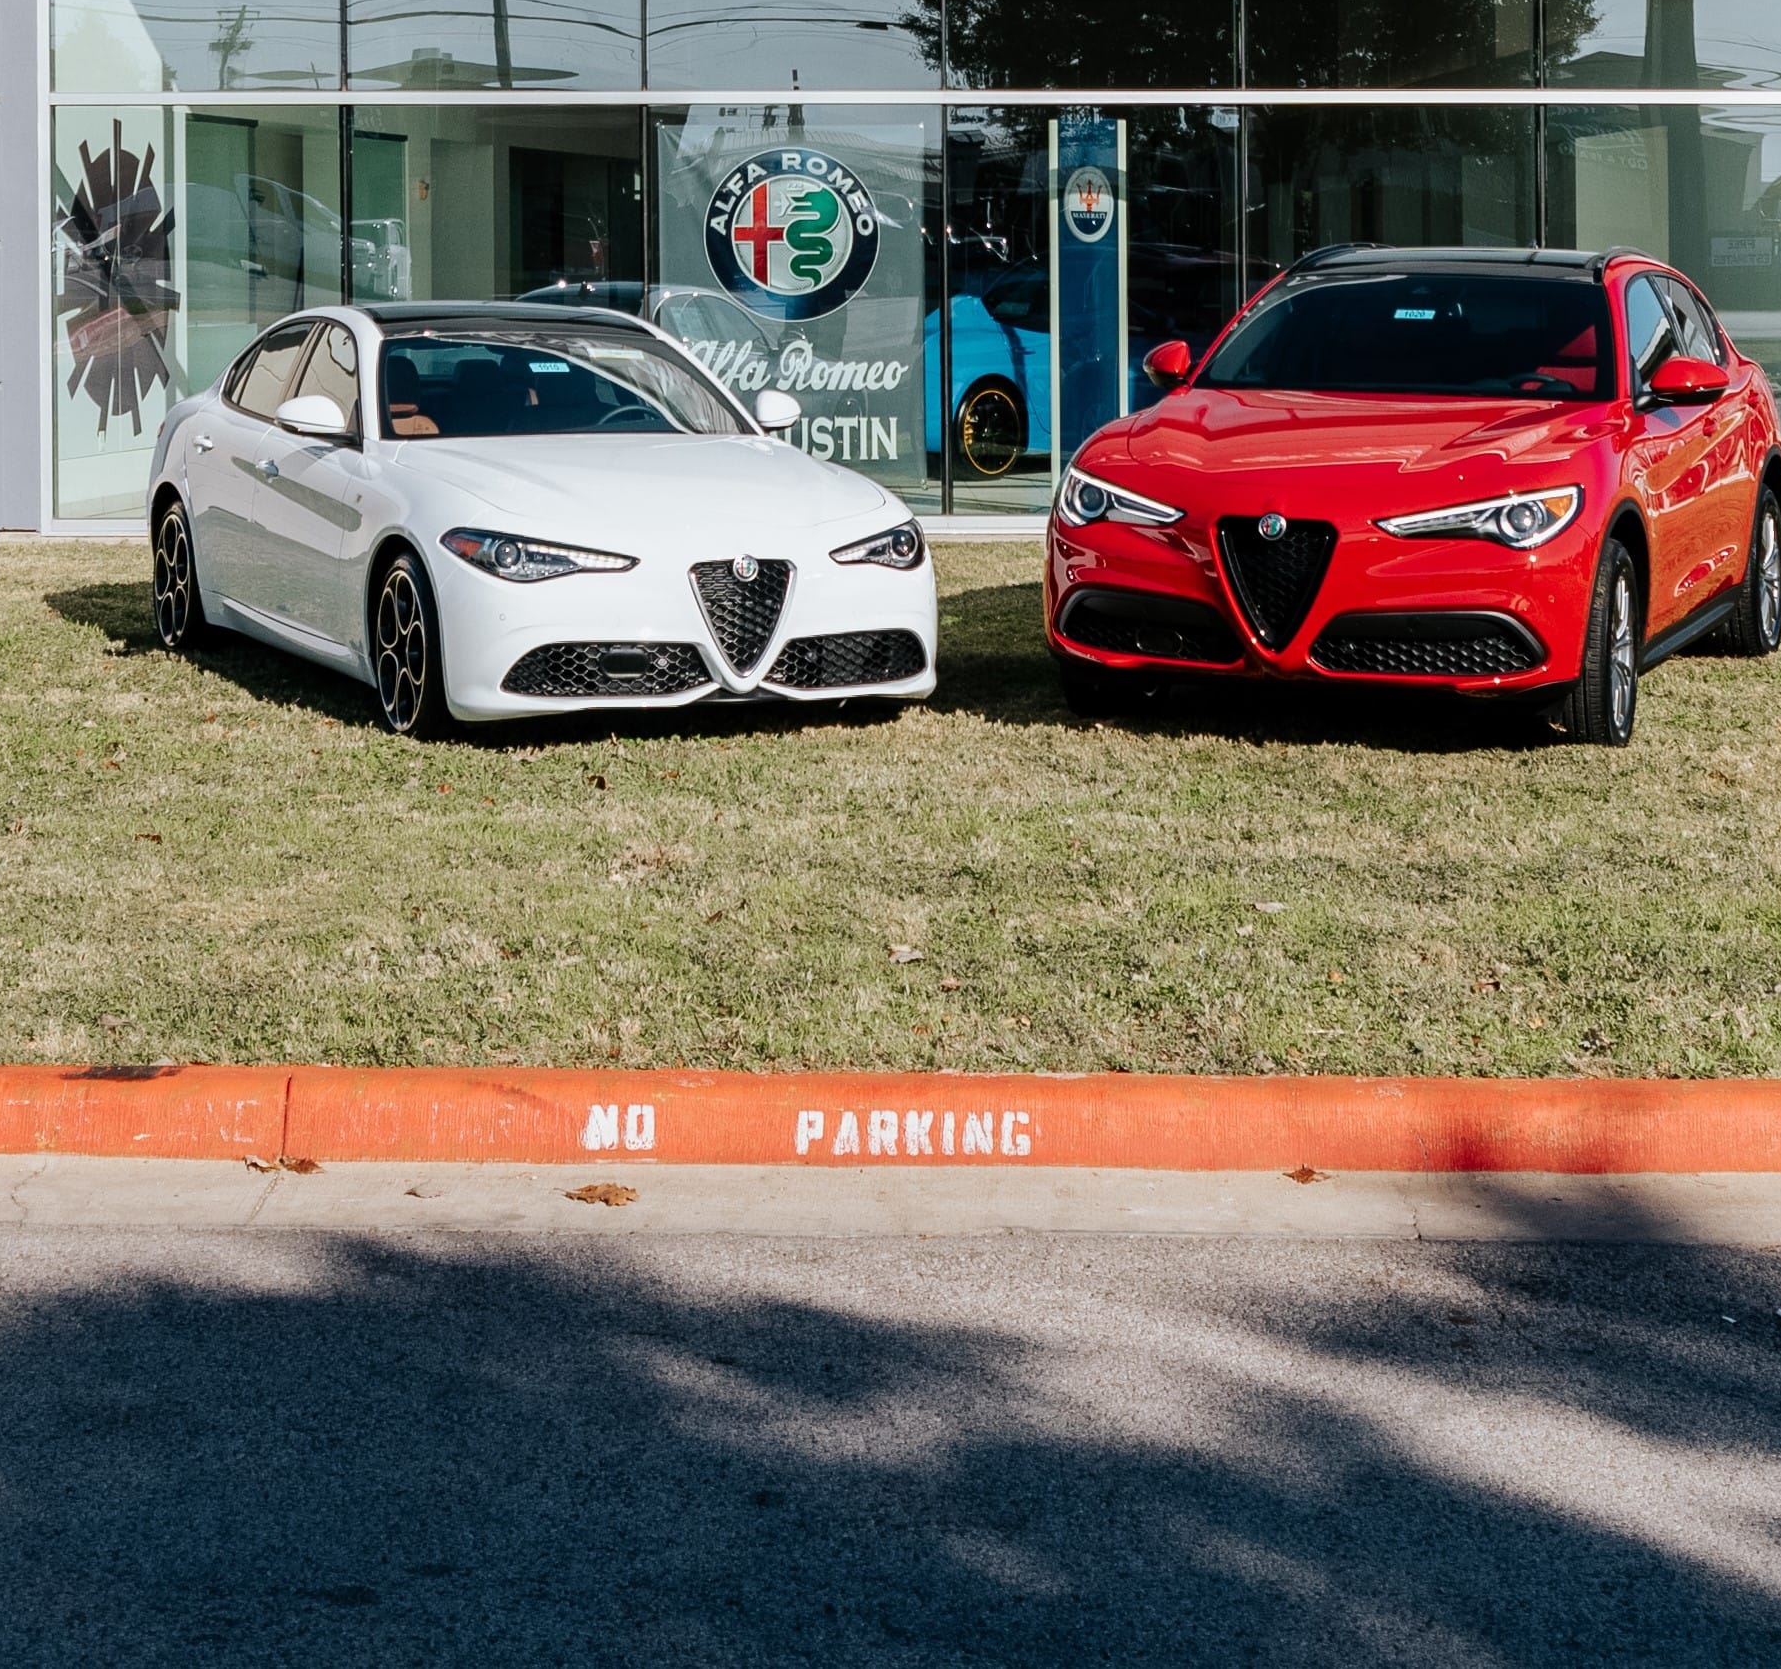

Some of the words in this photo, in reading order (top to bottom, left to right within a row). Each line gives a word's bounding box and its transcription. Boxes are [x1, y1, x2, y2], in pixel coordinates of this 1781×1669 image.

[710, 162, 769, 237] ALFA
[780, 152, 875, 237] ROMEO
[776, 339, 910, 392] Romeo
[770, 416, 899, 462] USTIN
[581, 1104, 656, 1151] NO
[793, 1109, 1032, 1157] PARKING
